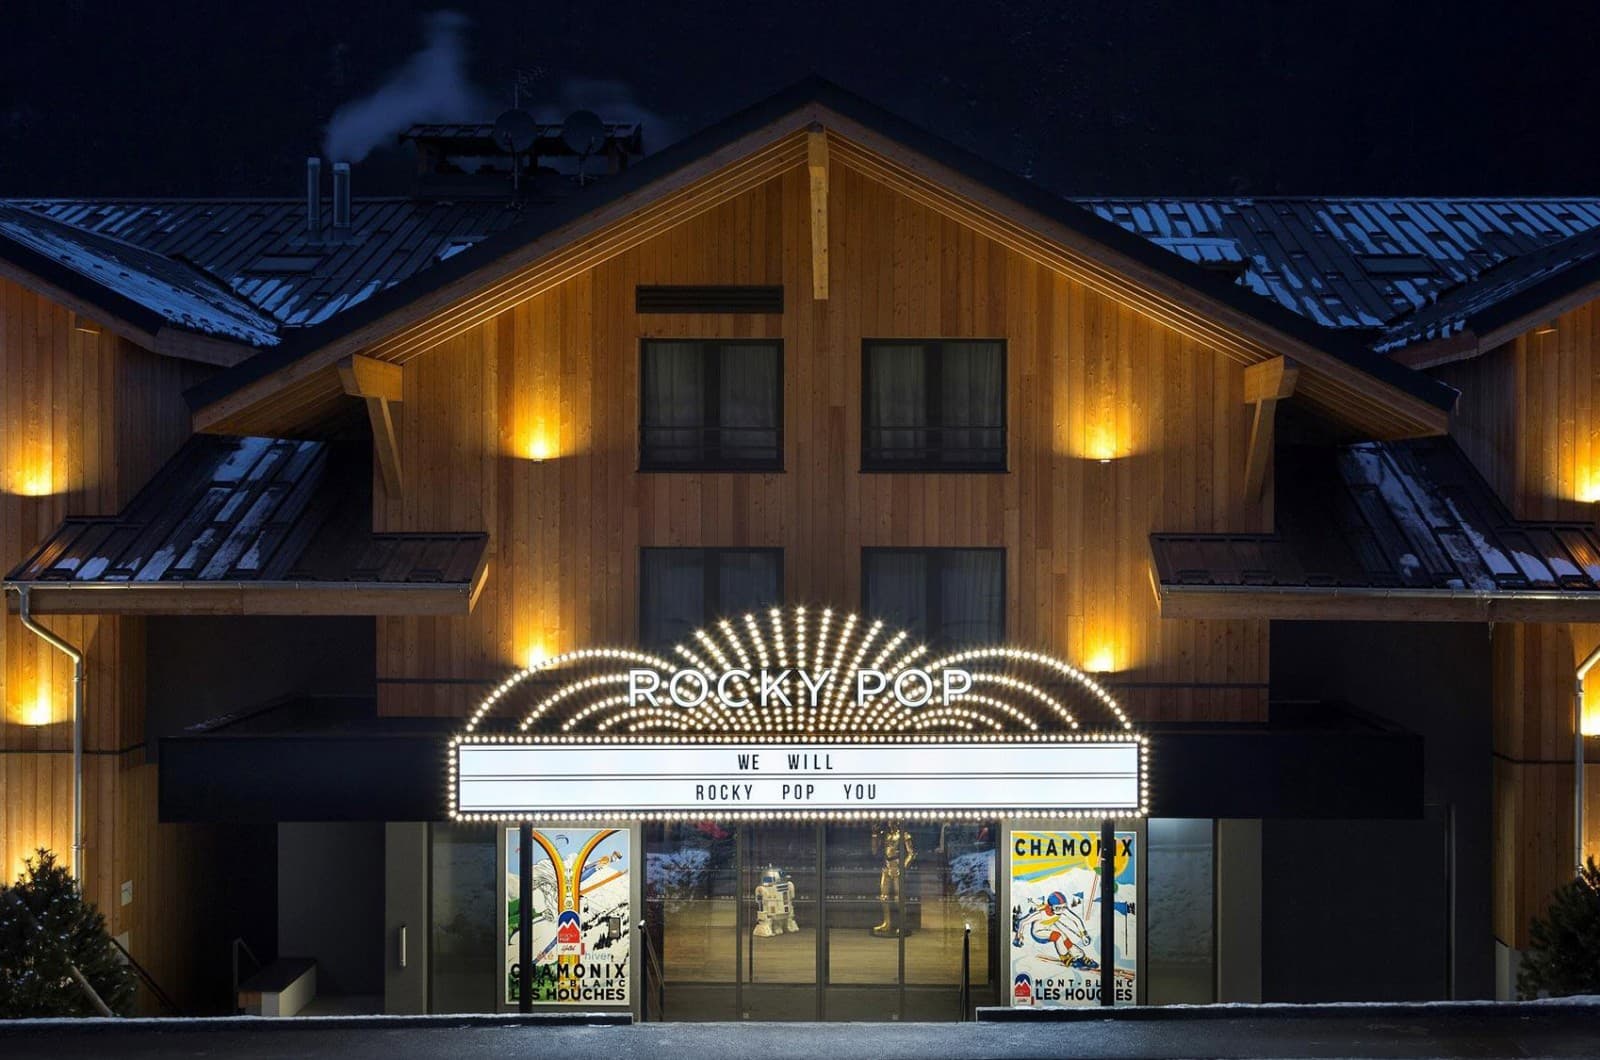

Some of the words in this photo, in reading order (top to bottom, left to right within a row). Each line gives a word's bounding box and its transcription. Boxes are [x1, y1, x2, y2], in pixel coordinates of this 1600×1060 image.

[628, 669, 832, 708] ROCKY
[857, 669, 973, 708] POP
[737, 753, 760, 770] WE
[787, 753, 834, 770] WILL
[695, 784, 753, 801] ROCKY
[782, 784, 815, 800] POP
[843, 783, 877, 800] YOU
[511, 979, 626, 988] MNT-BLANC
[1035, 979, 1133, 988] MONT-BLNC
[512, 988, 540, 1001] LS
[546, 988, 626, 1001] HOUCHES
[1035, 988, 1060, 1001] LES
